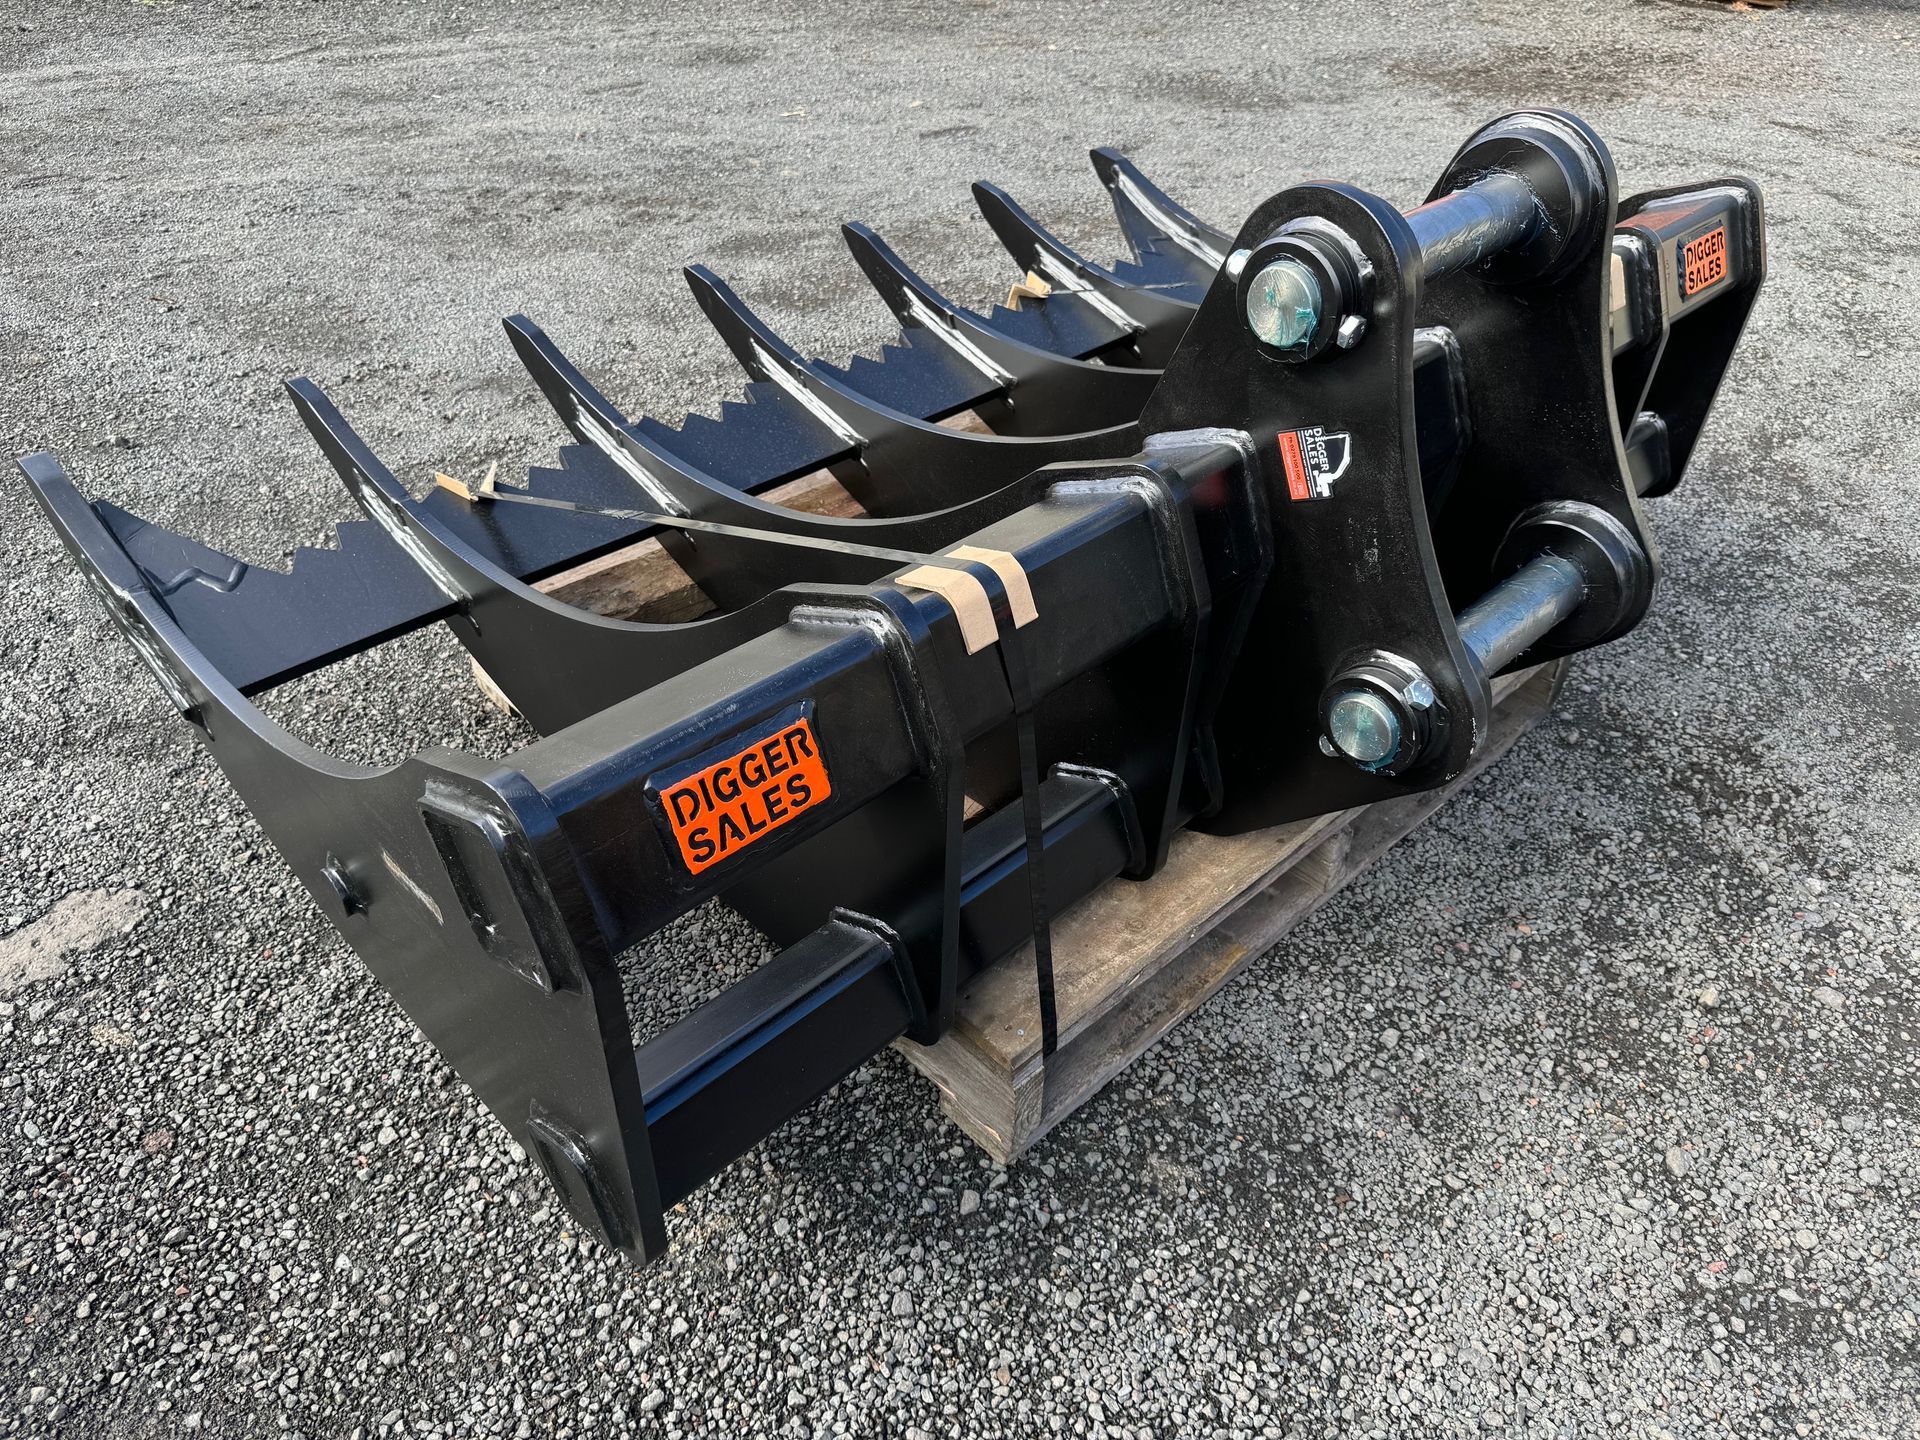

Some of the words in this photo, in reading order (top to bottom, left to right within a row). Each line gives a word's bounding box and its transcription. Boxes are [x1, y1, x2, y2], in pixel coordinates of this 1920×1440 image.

[1686, 232, 1724, 268] DIGGER
[1689, 257, 1721, 290] SALES
[1305, 429, 1319, 464] SALES
[1313, 428, 1329, 471] DIGGER
[670, 728, 812, 827] DIGGER
[688, 774, 811, 862] SALES
